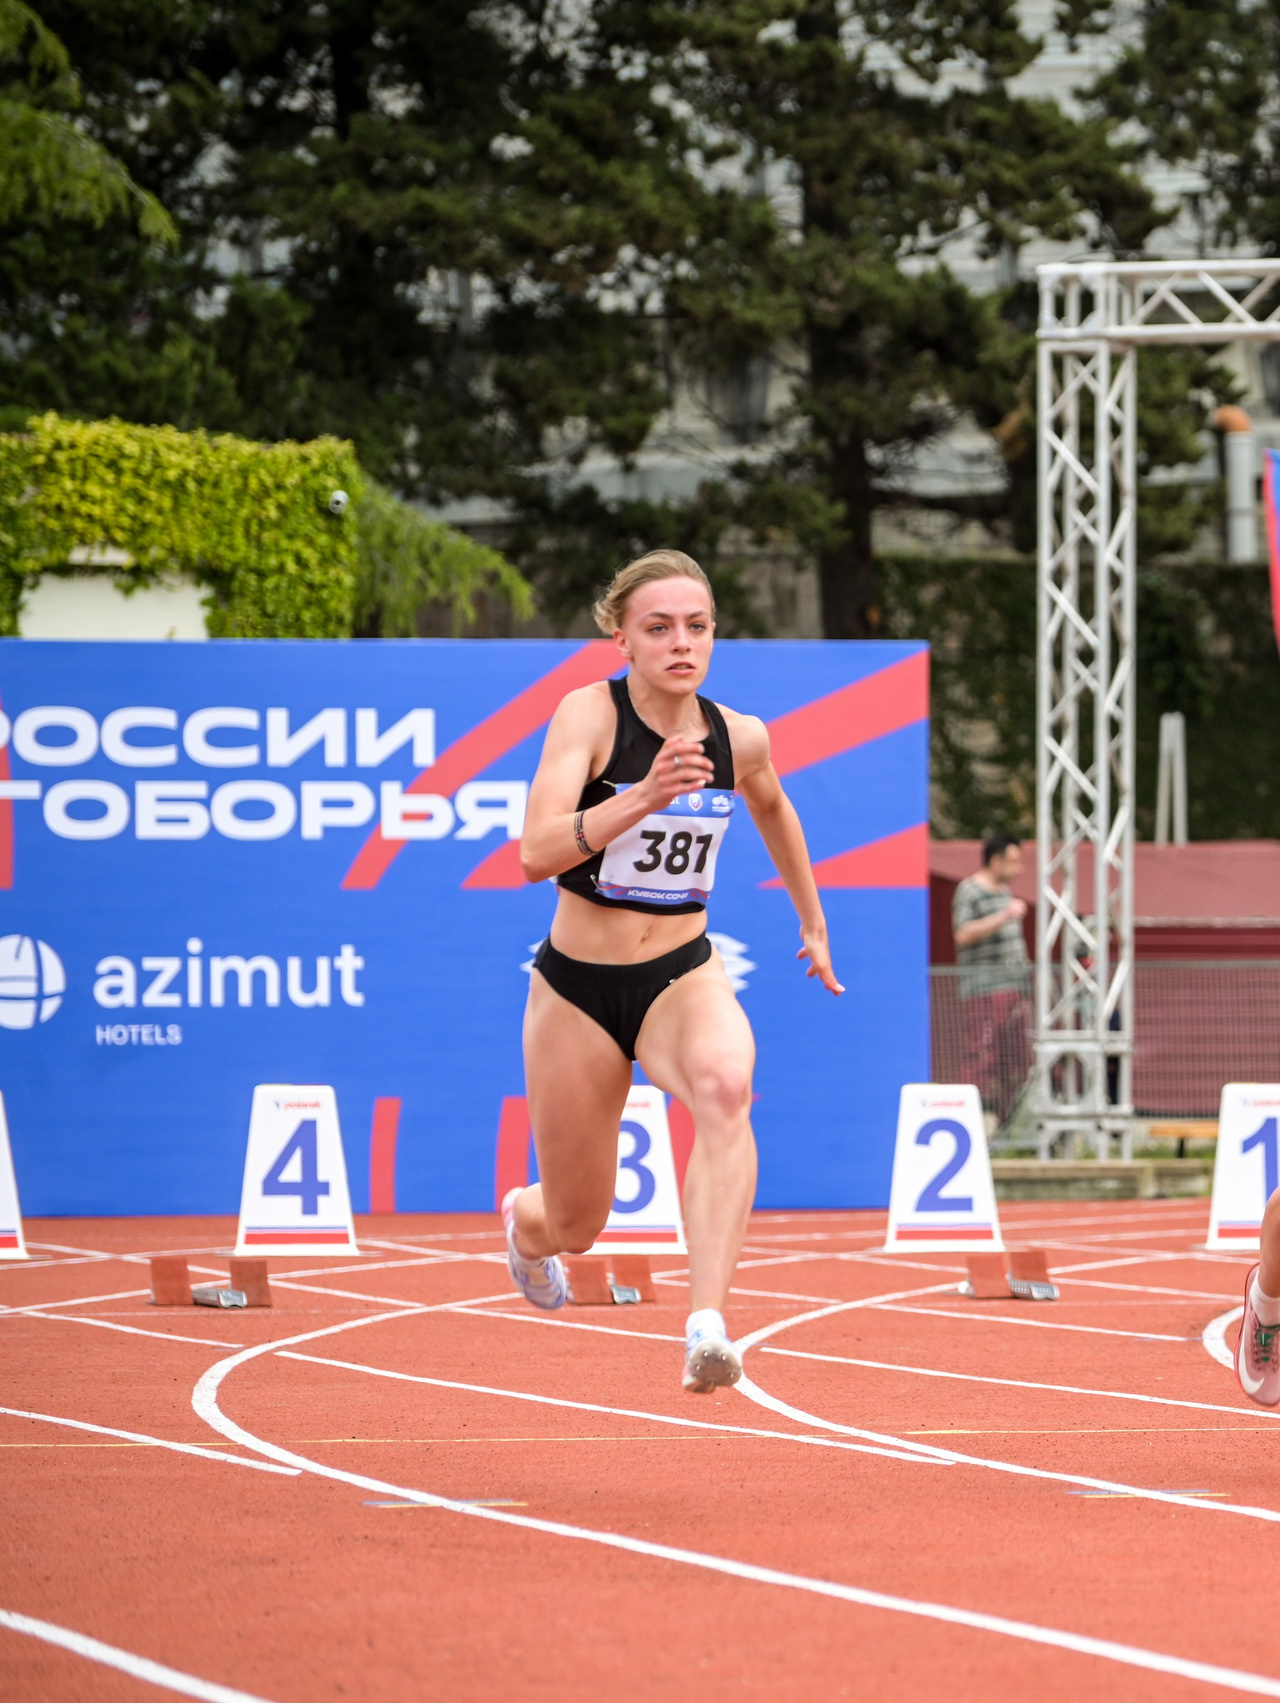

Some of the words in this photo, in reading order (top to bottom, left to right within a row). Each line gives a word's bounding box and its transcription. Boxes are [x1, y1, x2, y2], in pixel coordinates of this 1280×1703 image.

[0, 705, 436, 768] ОССИИ
[633, 829, 713, 875] 381
[627, 889, 666, 899] КУБОК
[93, 936, 365, 1008] azimut
[95, 1023, 183, 1046] HOTELS
[262, 1118, 330, 1215] 4
[611, 1120, 656, 1214] 3
[914, 1118, 973, 1212] 2
[1241, 1116, 1279, 1207] 1
